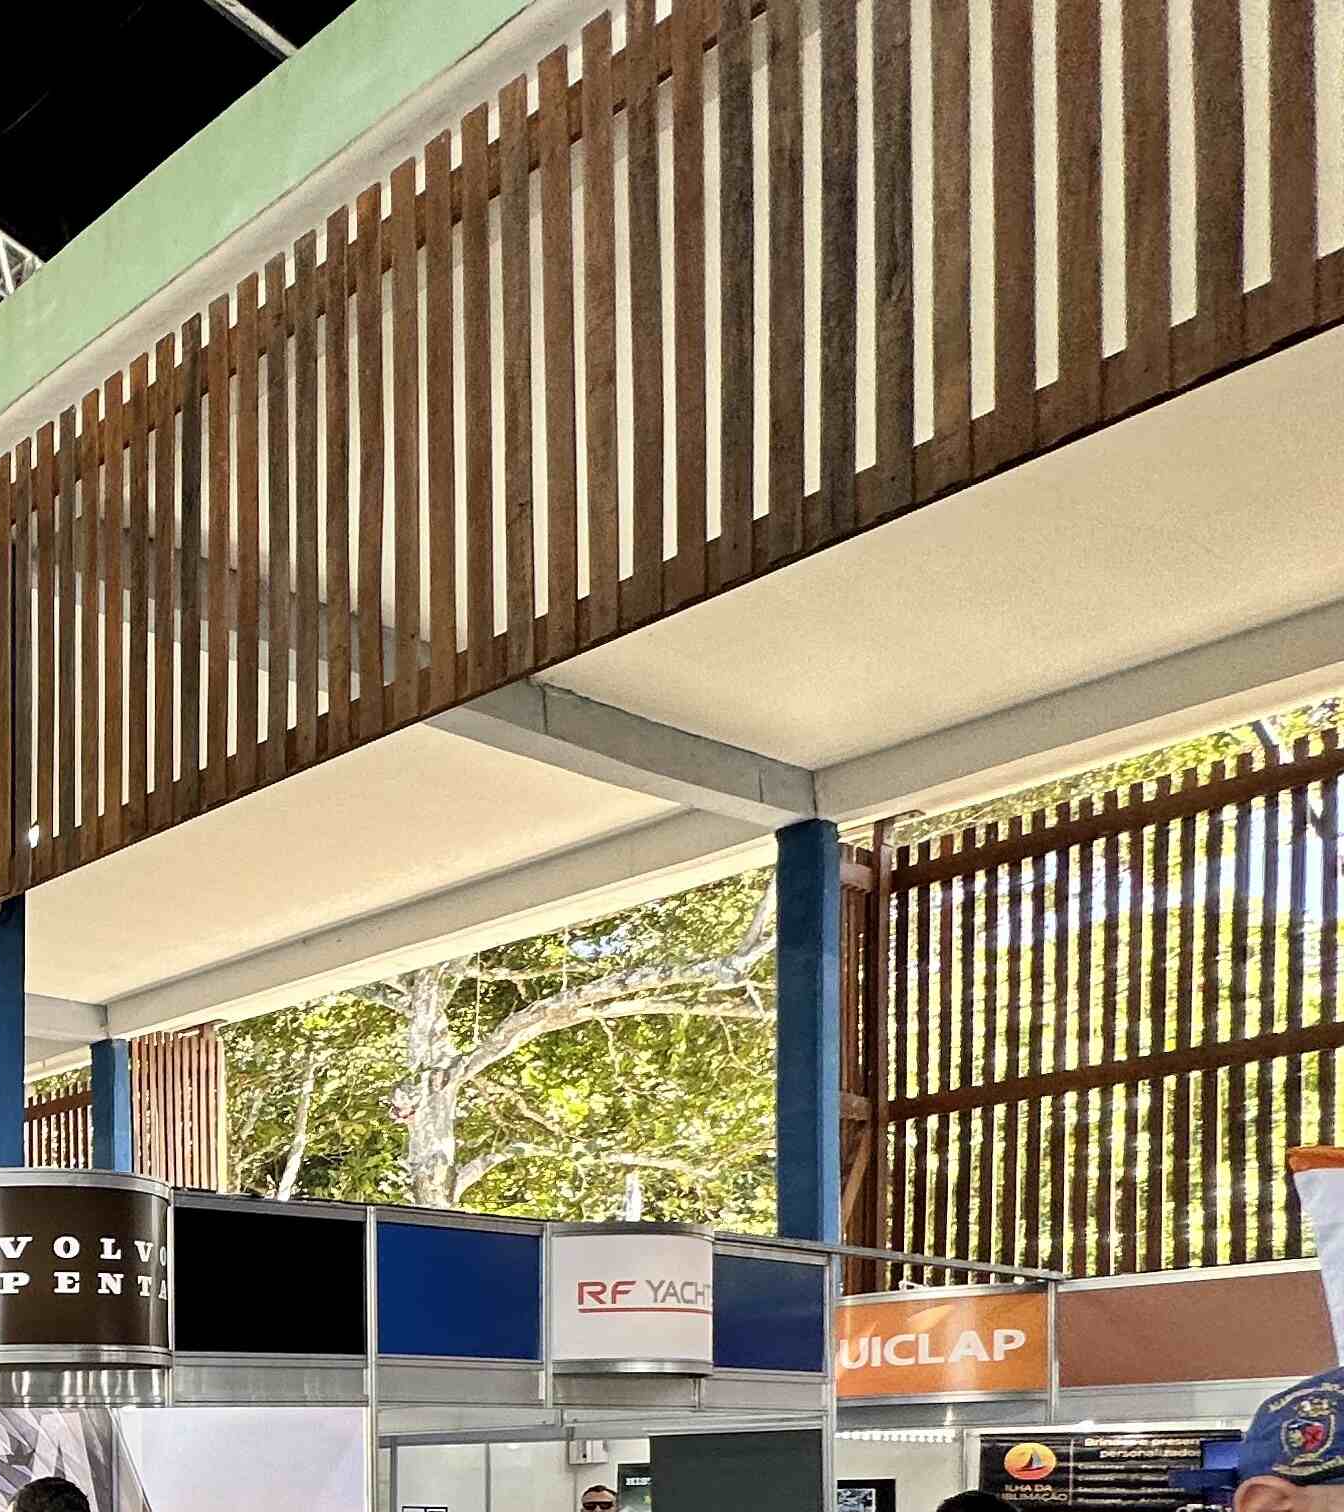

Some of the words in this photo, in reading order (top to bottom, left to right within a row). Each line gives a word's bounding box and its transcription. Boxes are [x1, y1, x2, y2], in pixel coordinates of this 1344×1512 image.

[577, 1280, 637, 1306] RF
[645, 1279, 713, 1307] YACHT
[837, 1328, 1027, 1370] UICLAP
